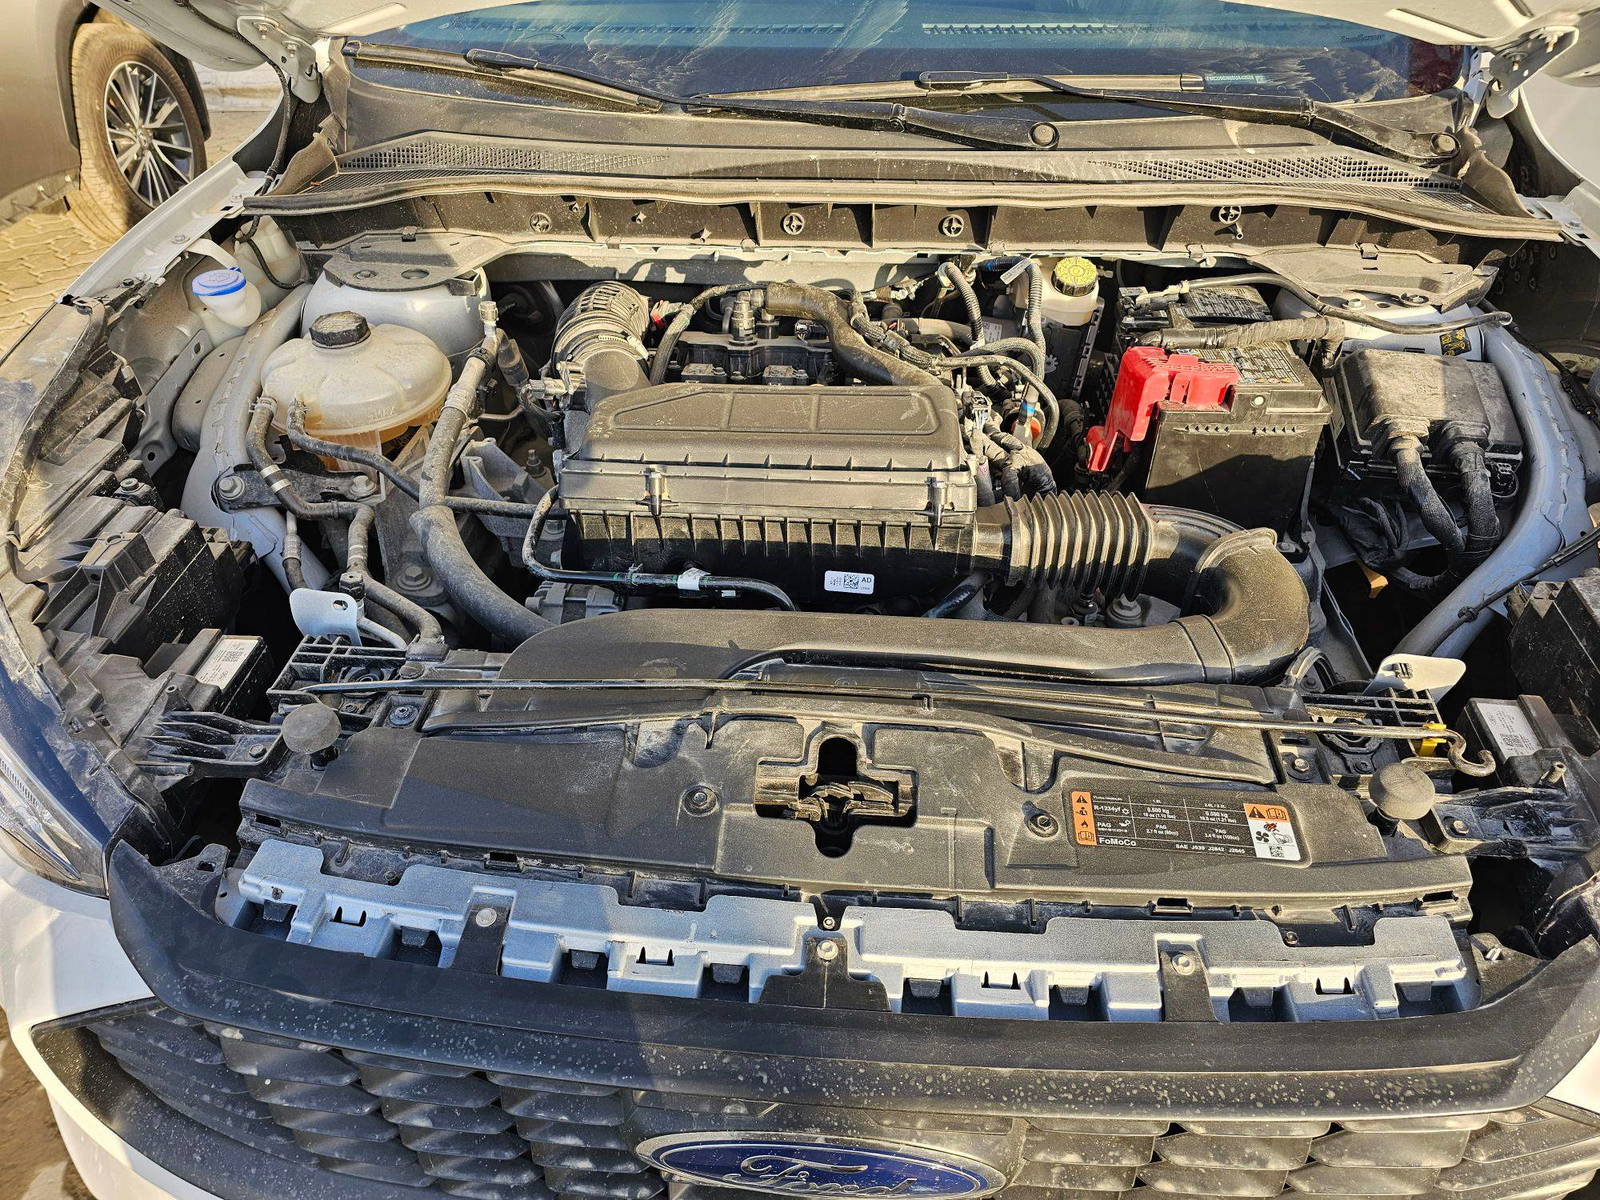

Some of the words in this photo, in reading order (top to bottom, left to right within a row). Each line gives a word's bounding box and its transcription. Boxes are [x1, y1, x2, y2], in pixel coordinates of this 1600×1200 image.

[1094, 805, 1121, 813] R-1234yf
[1099, 838, 1137, 847] FoMoCo
[722, 1154, 918, 1197] Ford
